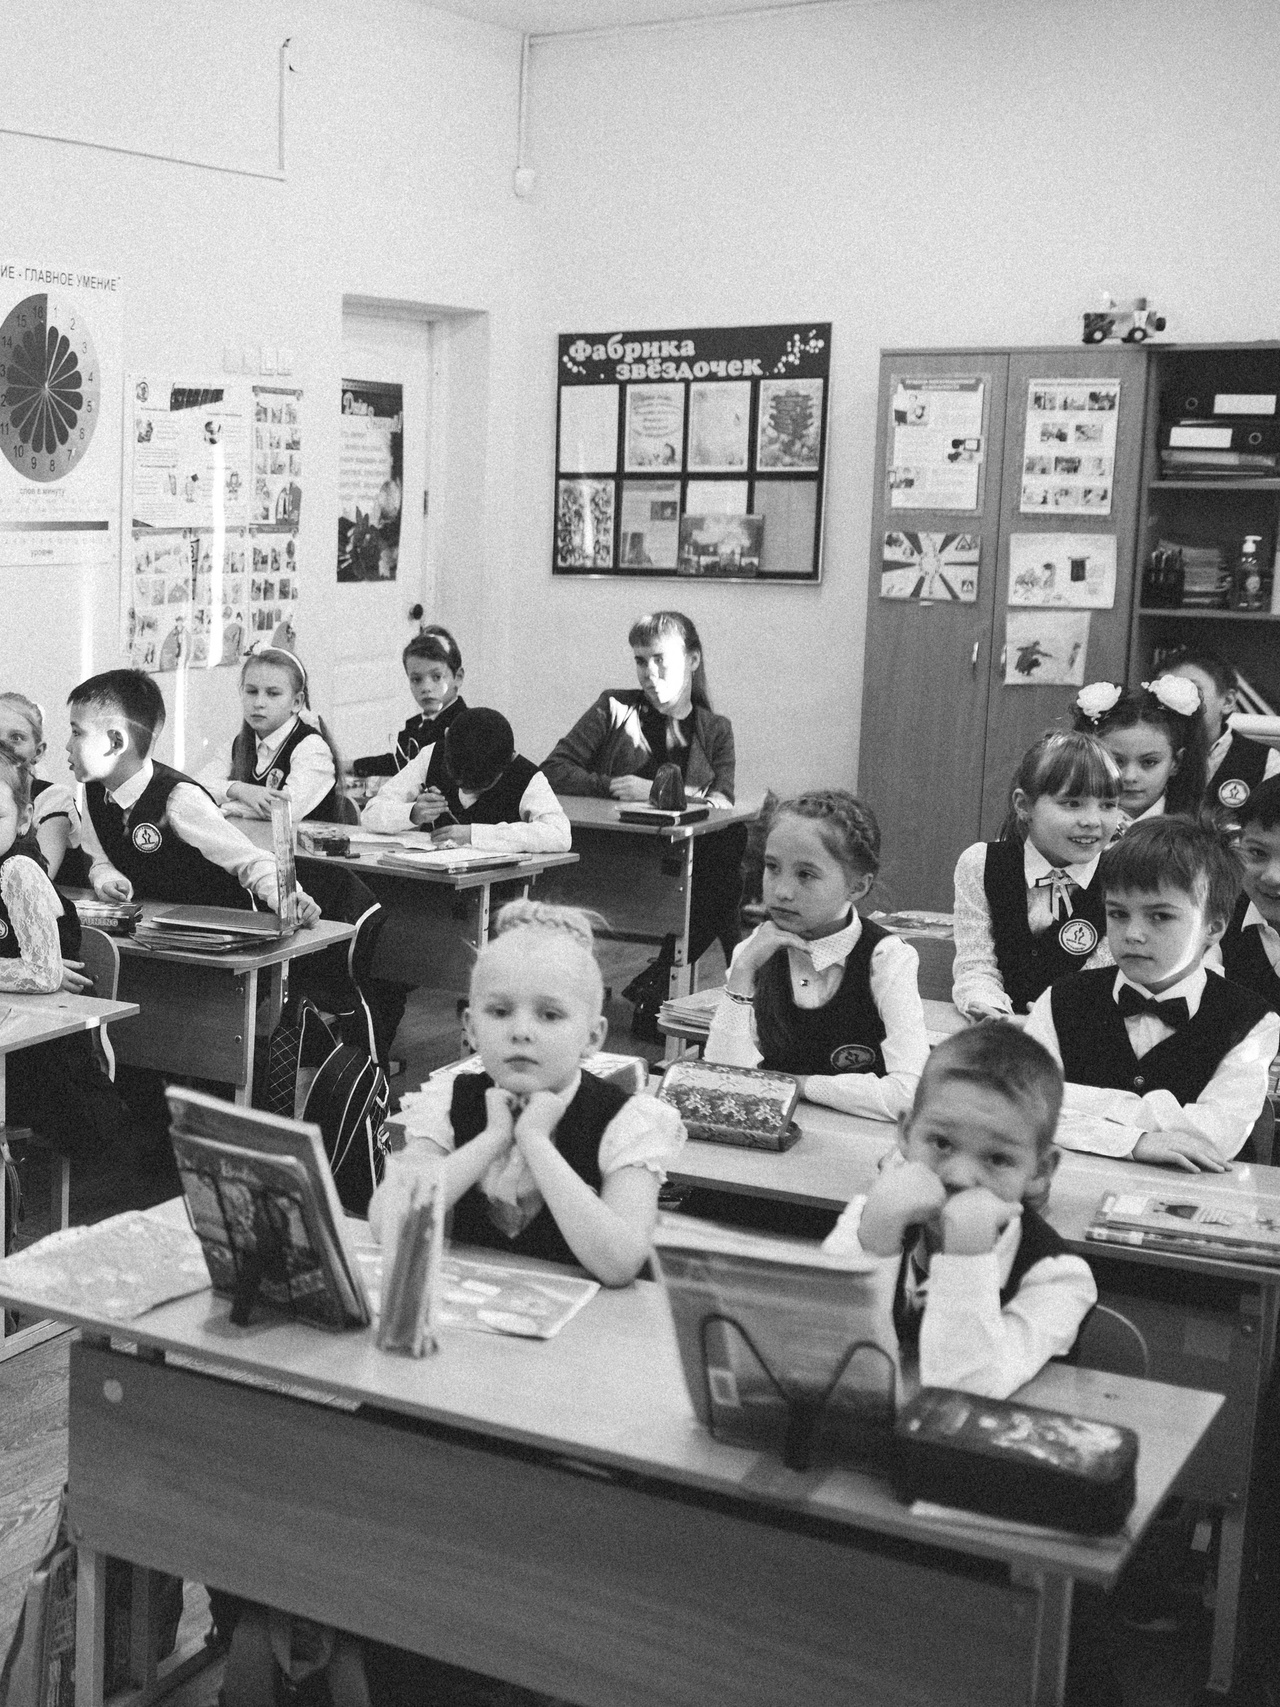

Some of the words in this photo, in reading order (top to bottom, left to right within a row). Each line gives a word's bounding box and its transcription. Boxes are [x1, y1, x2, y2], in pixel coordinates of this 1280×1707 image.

[24, 268, 73, 286] ГЛАВНОЕ
[16, 315, 27, 327] 15
[70, 317, 76, 330] 2
[2, 336, 13, 348] 14
[82, 342, 88, 354] 3
[568, 333, 696, 363] Фабрика
[615, 358, 764, 381] звёздочек
[88, 372, 94, 383] 4
[86, 400, 93, 413] 5
[0, 423, 10, 435] 11
[79, 428, 85, 440] 6
[13, 445, 24, 458] 10
[67, 449, 73, 461] 7
[31, 456, 37, 470] 9
[49, 460, 56, 472] 8
[80, 917, 119, 927] TUNING
